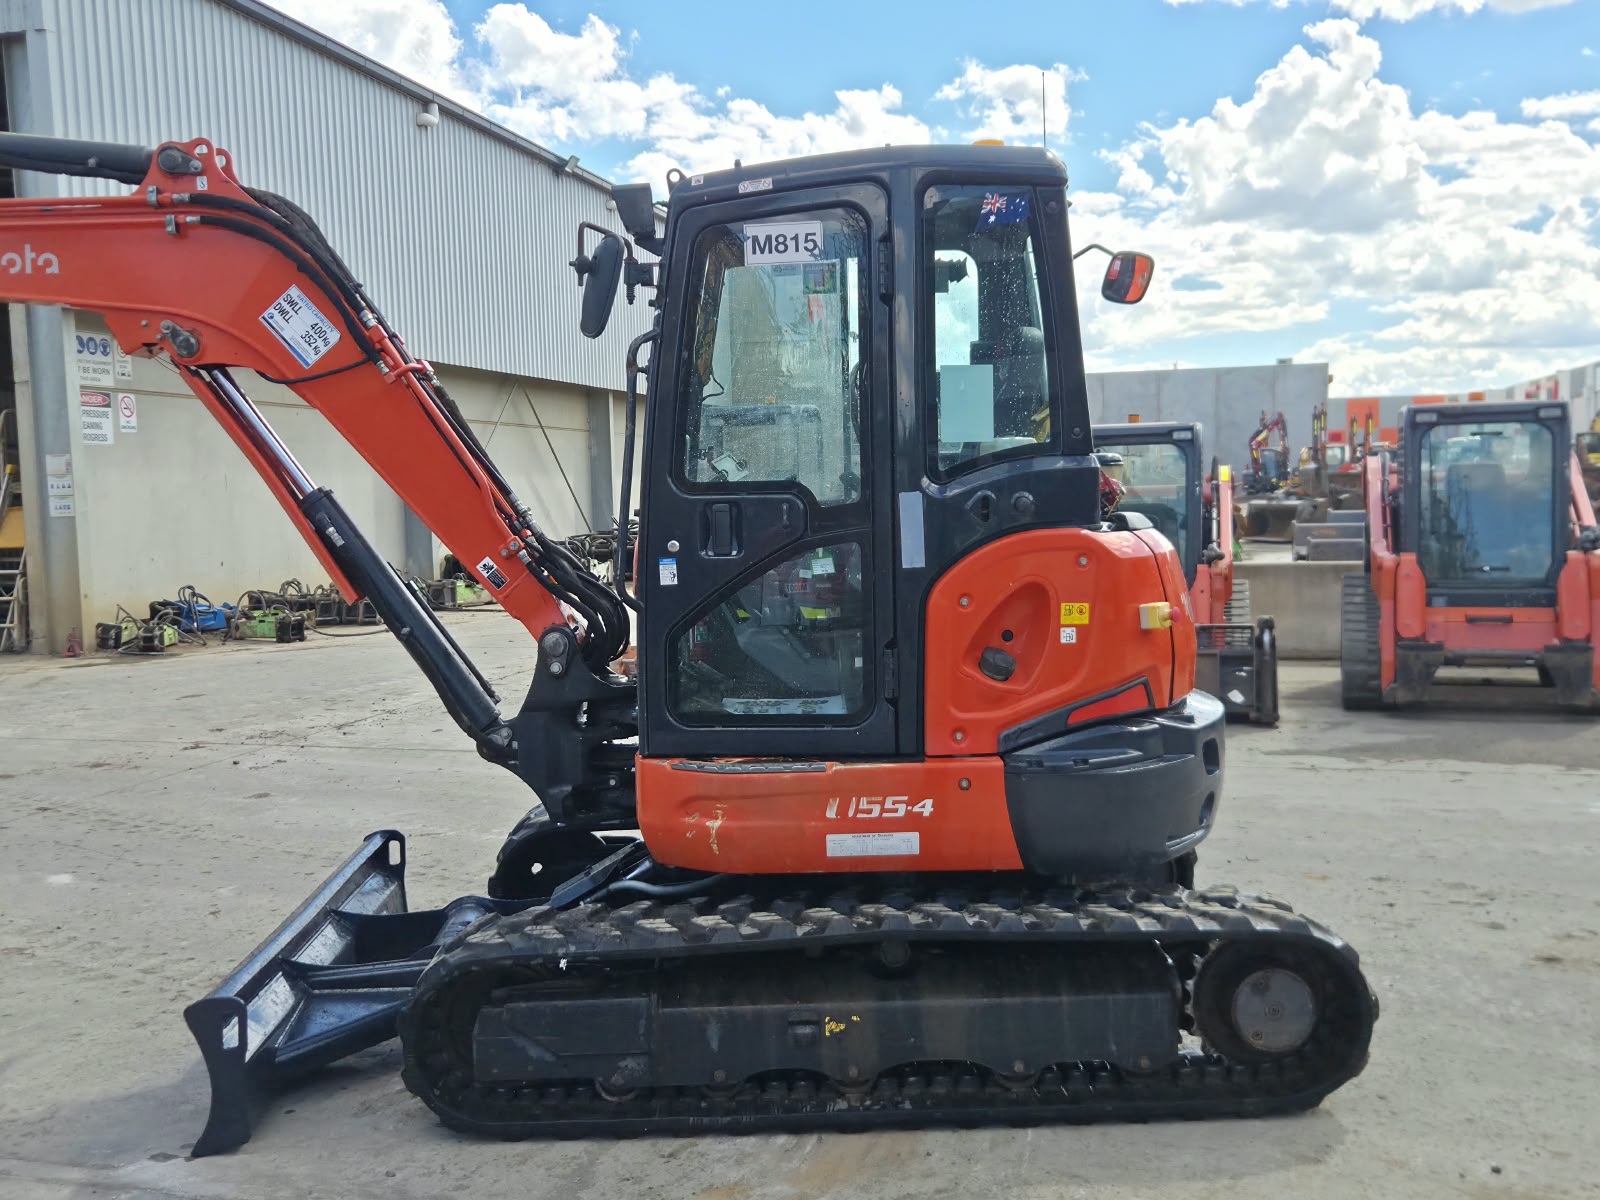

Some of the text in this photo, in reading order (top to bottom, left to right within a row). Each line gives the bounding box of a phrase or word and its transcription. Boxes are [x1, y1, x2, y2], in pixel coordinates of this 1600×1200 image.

[751, 232, 818, 255] M815
[273, 303, 294, 325] DWLL
[300, 330, 318, 348] 352
[282, 293, 303, 316] SWLL
[310, 322, 327, 339] 400
[296, 294, 337, 333] RATED CAPACITY
[82, 366, 91, 374] BE
[92, 367, 111, 376] WORN
[81, 410, 110, 419] PRESSURE
